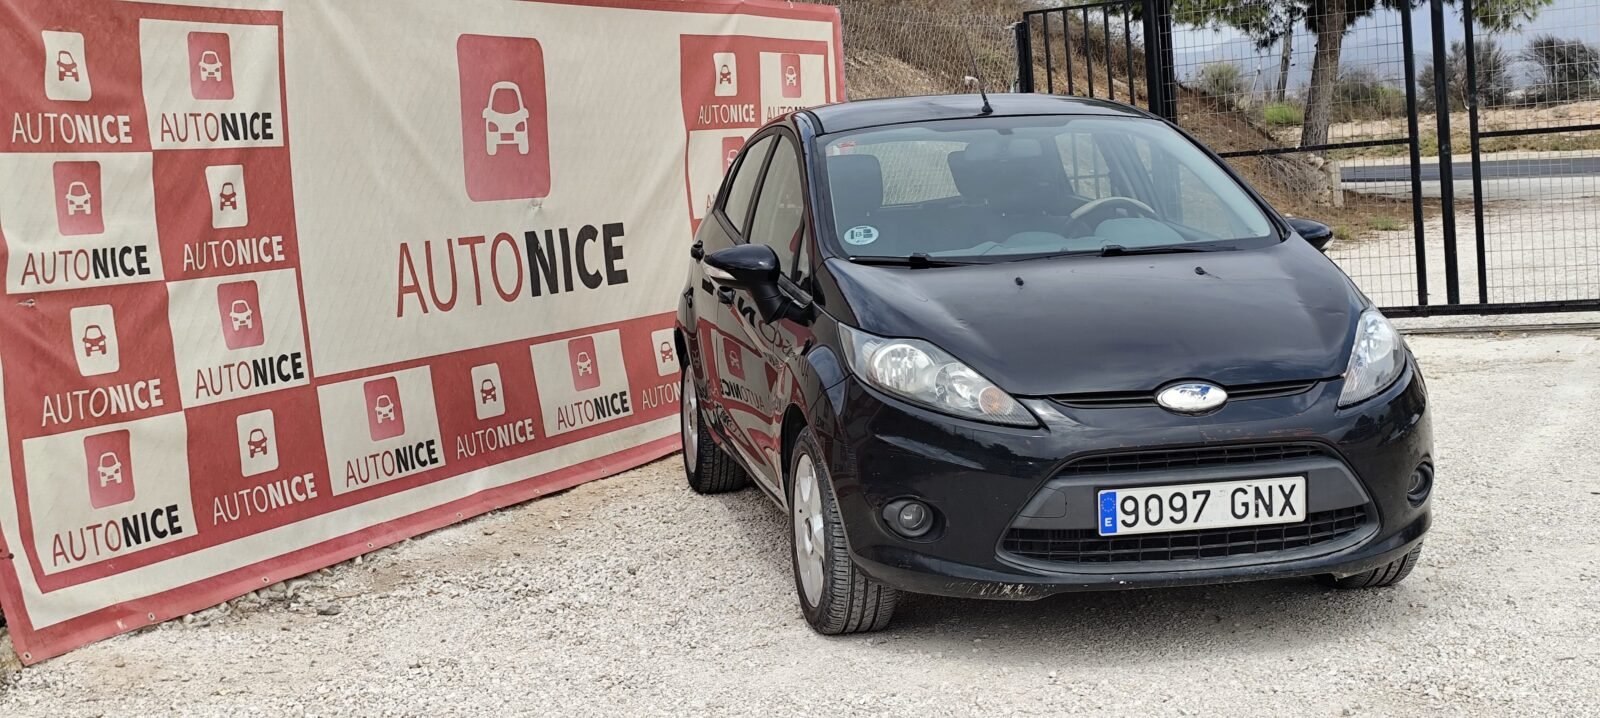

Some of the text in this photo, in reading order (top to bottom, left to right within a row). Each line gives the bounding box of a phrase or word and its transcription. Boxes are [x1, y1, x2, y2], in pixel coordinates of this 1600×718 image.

[12, 112, 133, 144] AUTONICE
[160, 112, 274, 143] AUTONICE
[697, 104, 756, 125] AUTONICE
[21, 245, 151, 286] AUTONICE
[183, 235, 285, 272] AUTONICE
[396, 222, 629, 318] AUTONICE
[196, 352, 305, 399] AUTONICE
[42, 378, 164, 427] AUTONICE
[557, 390, 630, 431] AUTONICE
[456, 418, 535, 460] AUTONICE
[345, 439, 439, 488] AUTONICE
[213, 472, 318, 526] AUTONICE
[1120, 483, 1297, 528] 9097 GNX
[52, 504, 183, 567] AUTONICE
[1104, 517, 1113, 527] E
